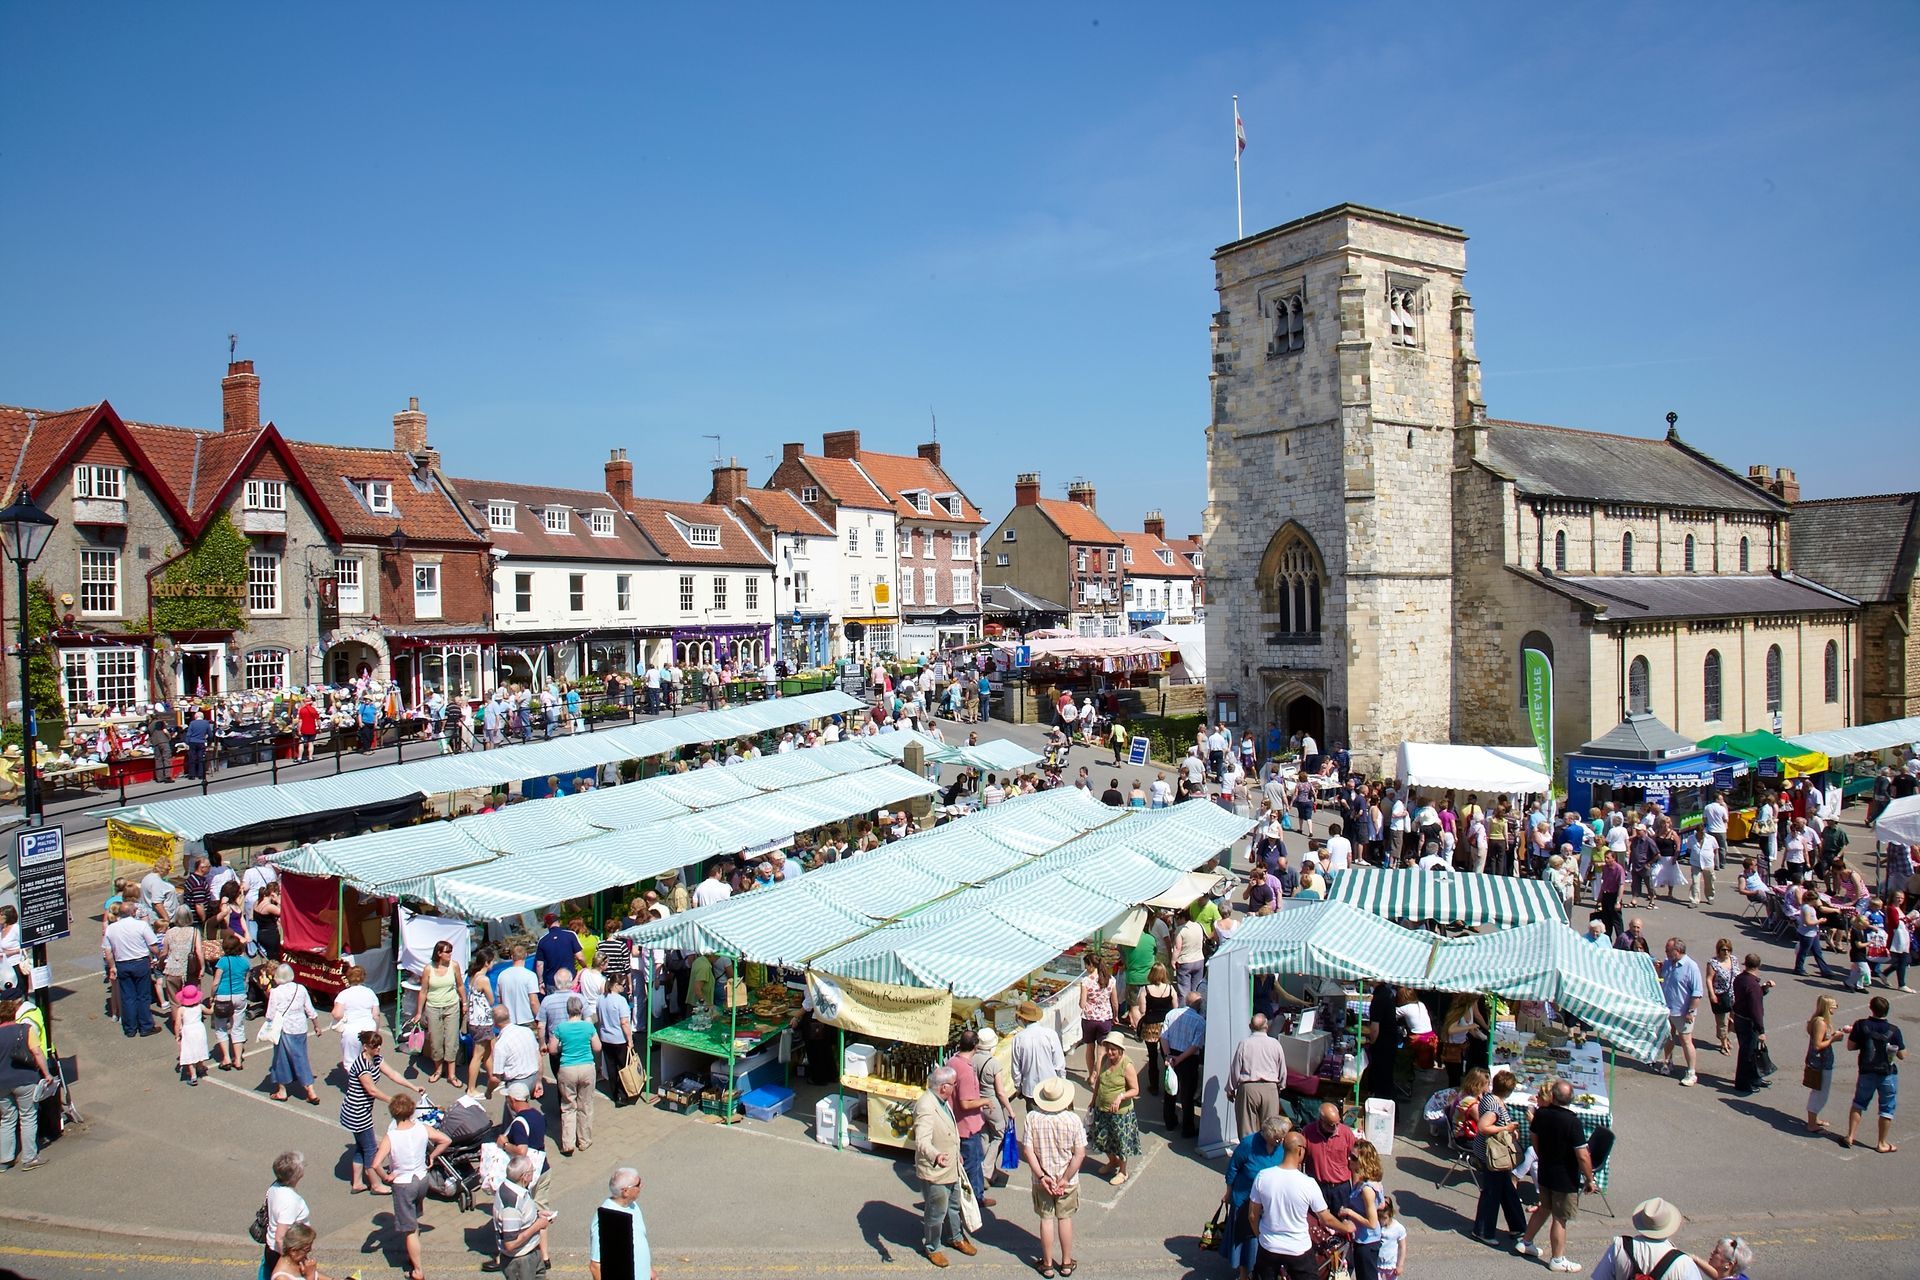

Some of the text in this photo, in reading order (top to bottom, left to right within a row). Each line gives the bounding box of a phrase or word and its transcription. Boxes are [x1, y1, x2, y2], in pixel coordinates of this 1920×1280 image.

[152, 583, 200, 597] KINGS
[23, 836, 37, 856] P
[45, 874, 65, 883] PARKING
[846, 984, 880, 1003] Family
